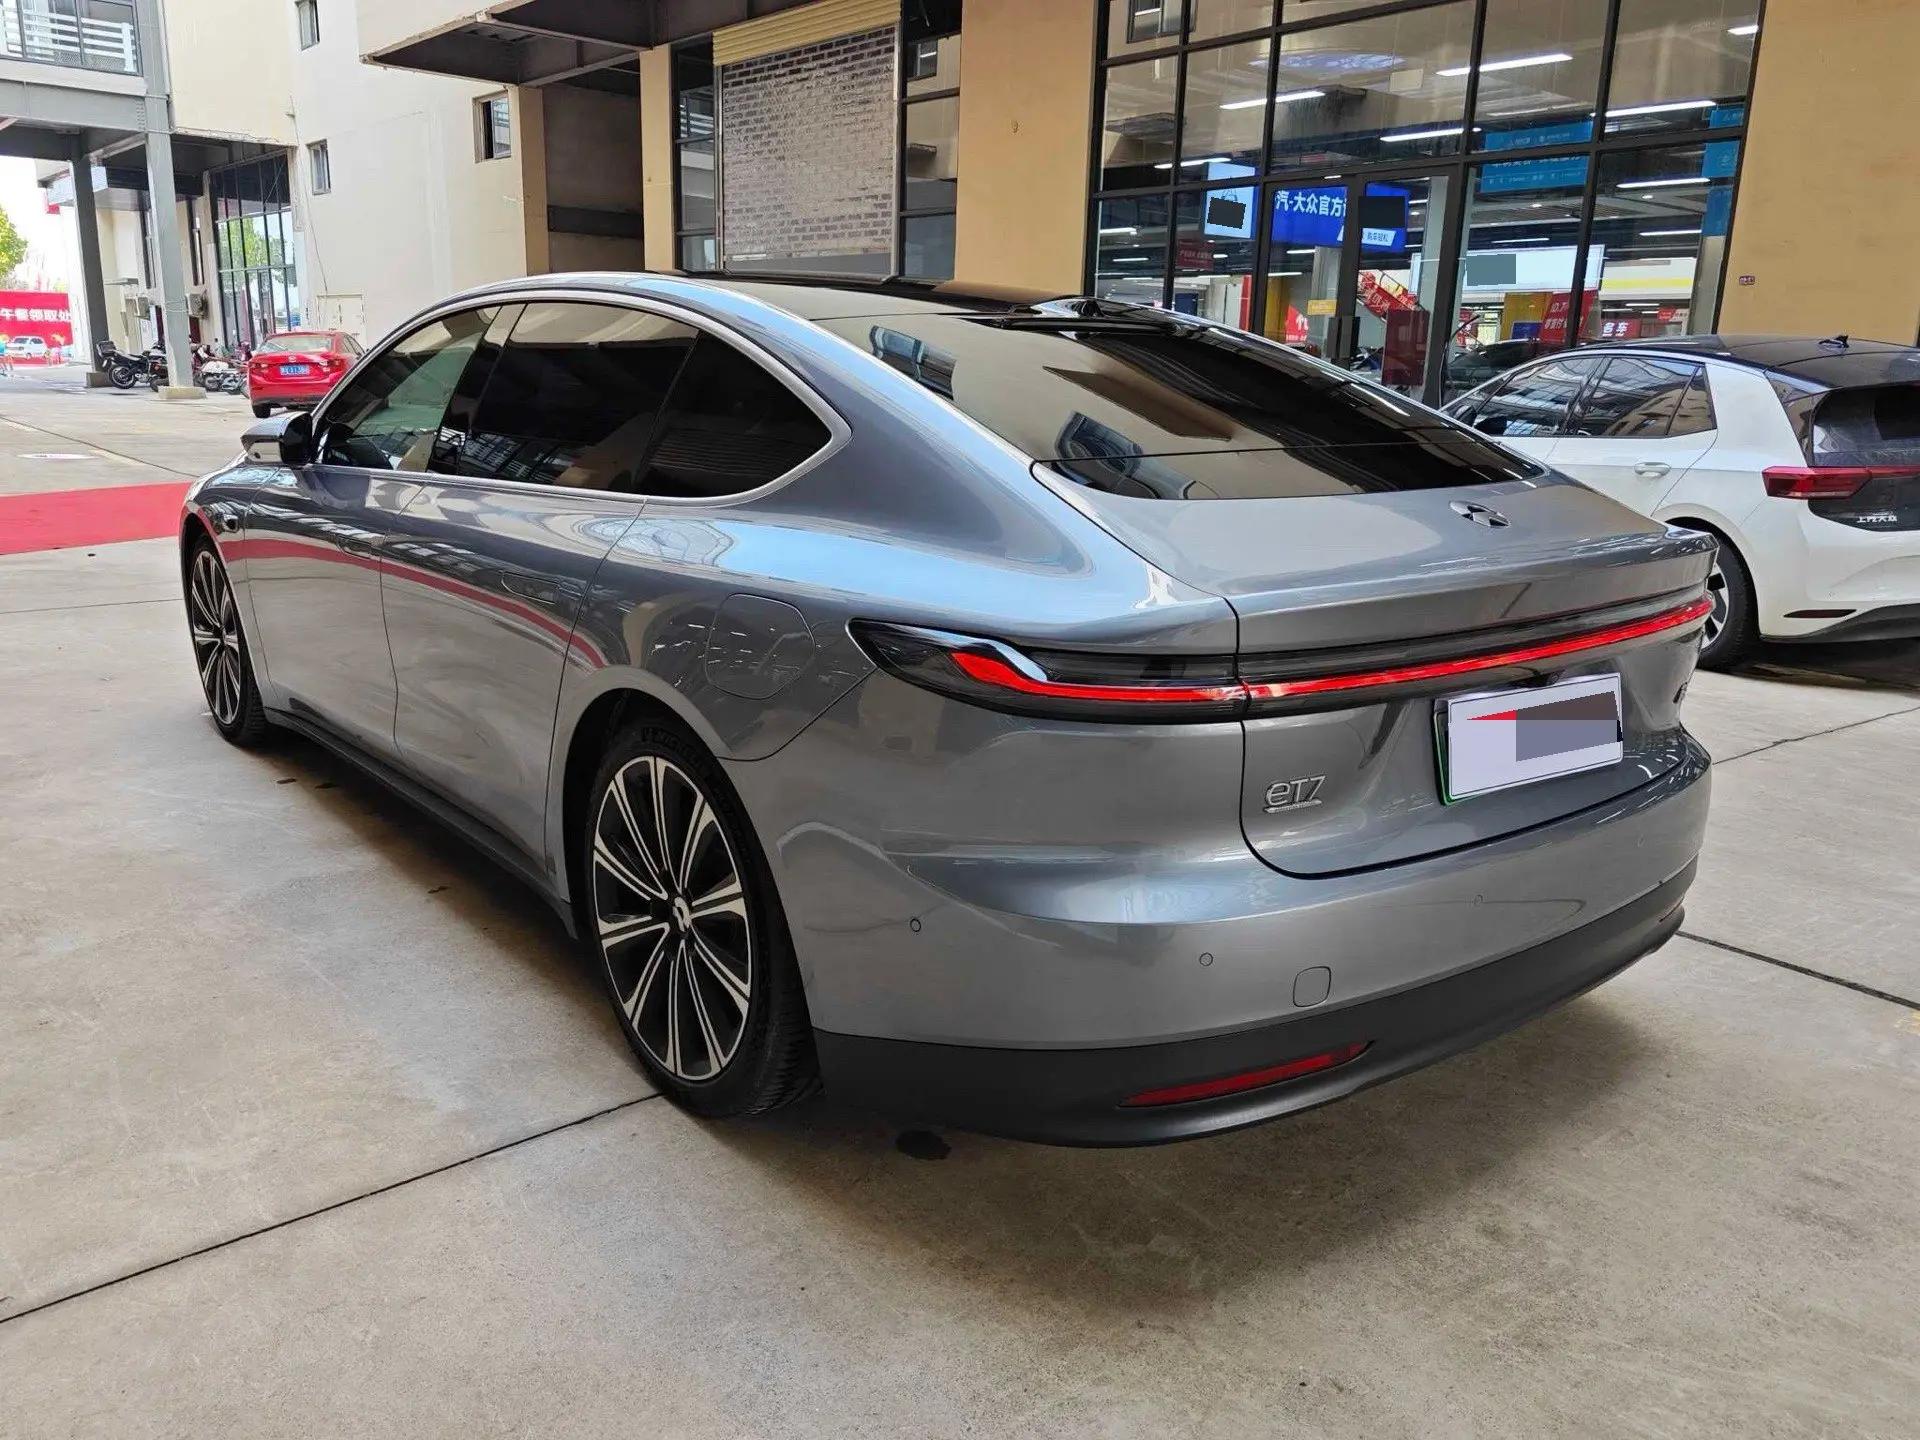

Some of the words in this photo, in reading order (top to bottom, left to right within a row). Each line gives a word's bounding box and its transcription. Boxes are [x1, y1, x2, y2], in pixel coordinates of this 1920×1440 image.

[1275, 190, 1346, 217] 汽-大众官方
